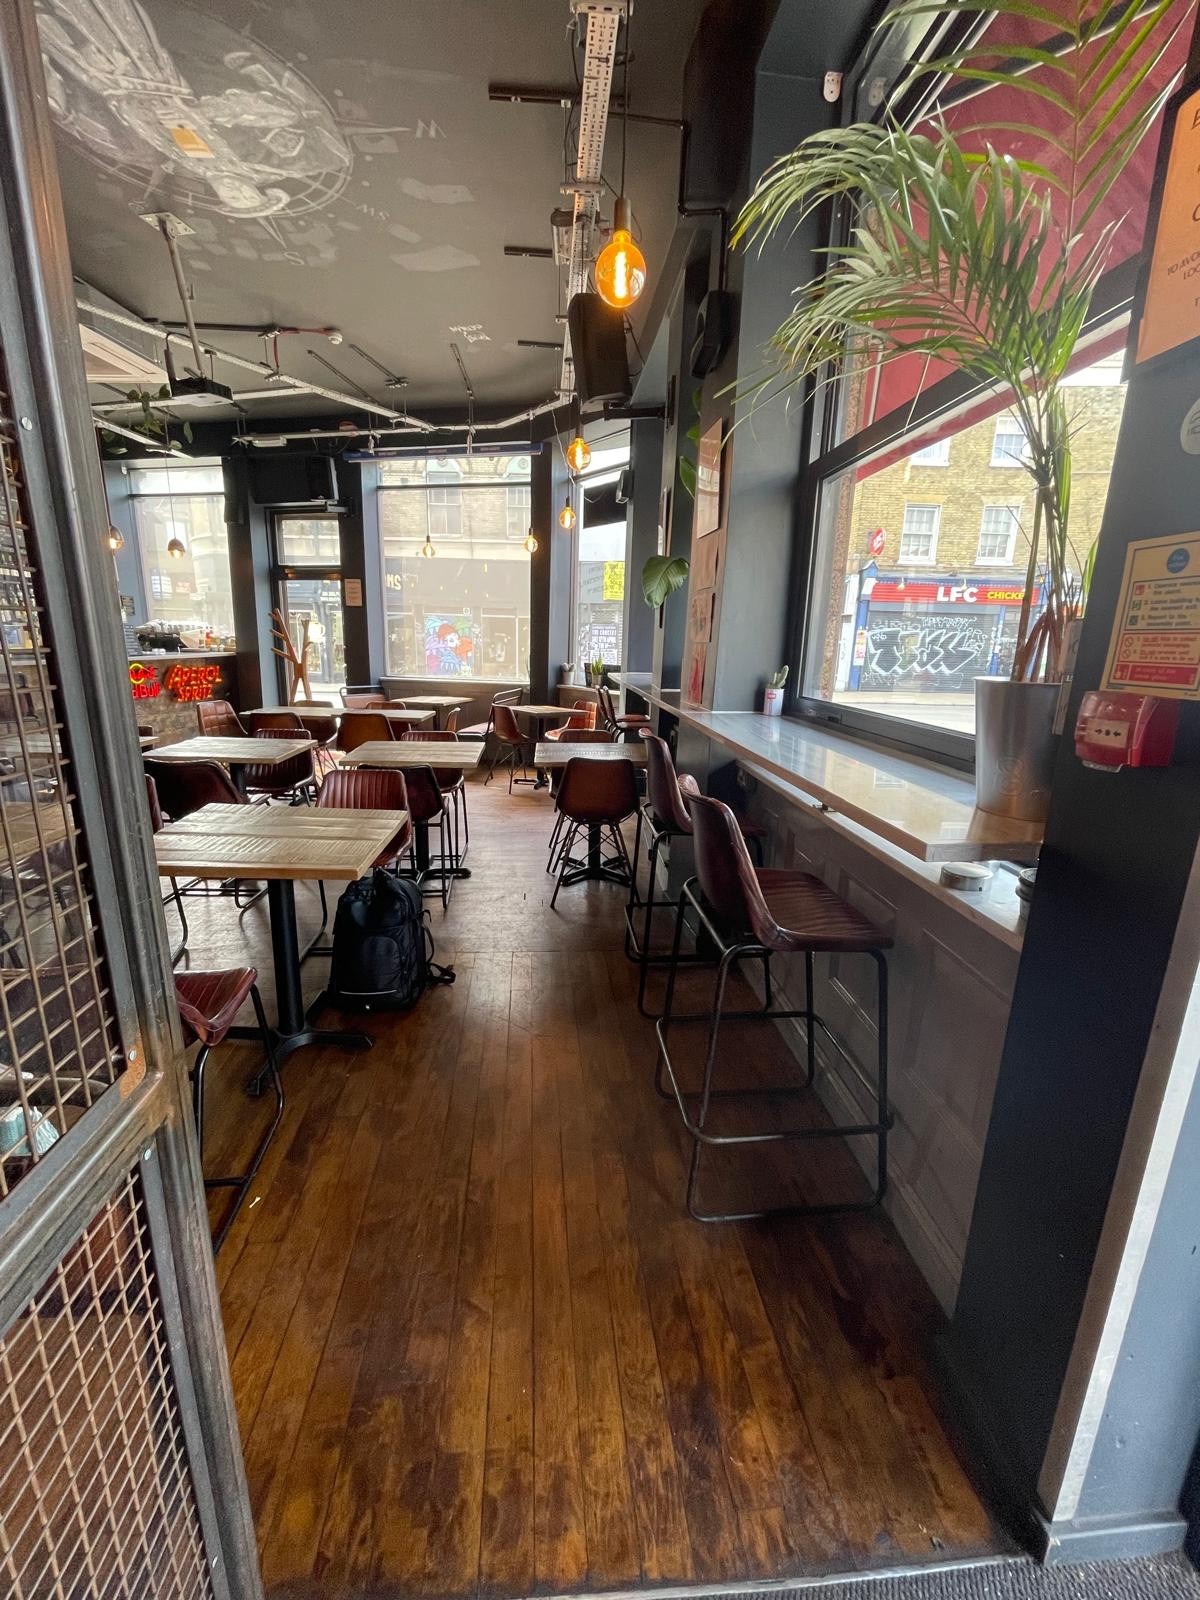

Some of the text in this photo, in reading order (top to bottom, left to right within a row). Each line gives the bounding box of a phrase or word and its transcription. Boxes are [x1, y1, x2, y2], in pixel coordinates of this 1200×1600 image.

[1179, 251, 1200, 271] AVO
[937, 586, 1025, 603] LFC CHICKE
[168, 664, 222, 689] APEROL
[177, 684, 213, 702] SPRITZ
